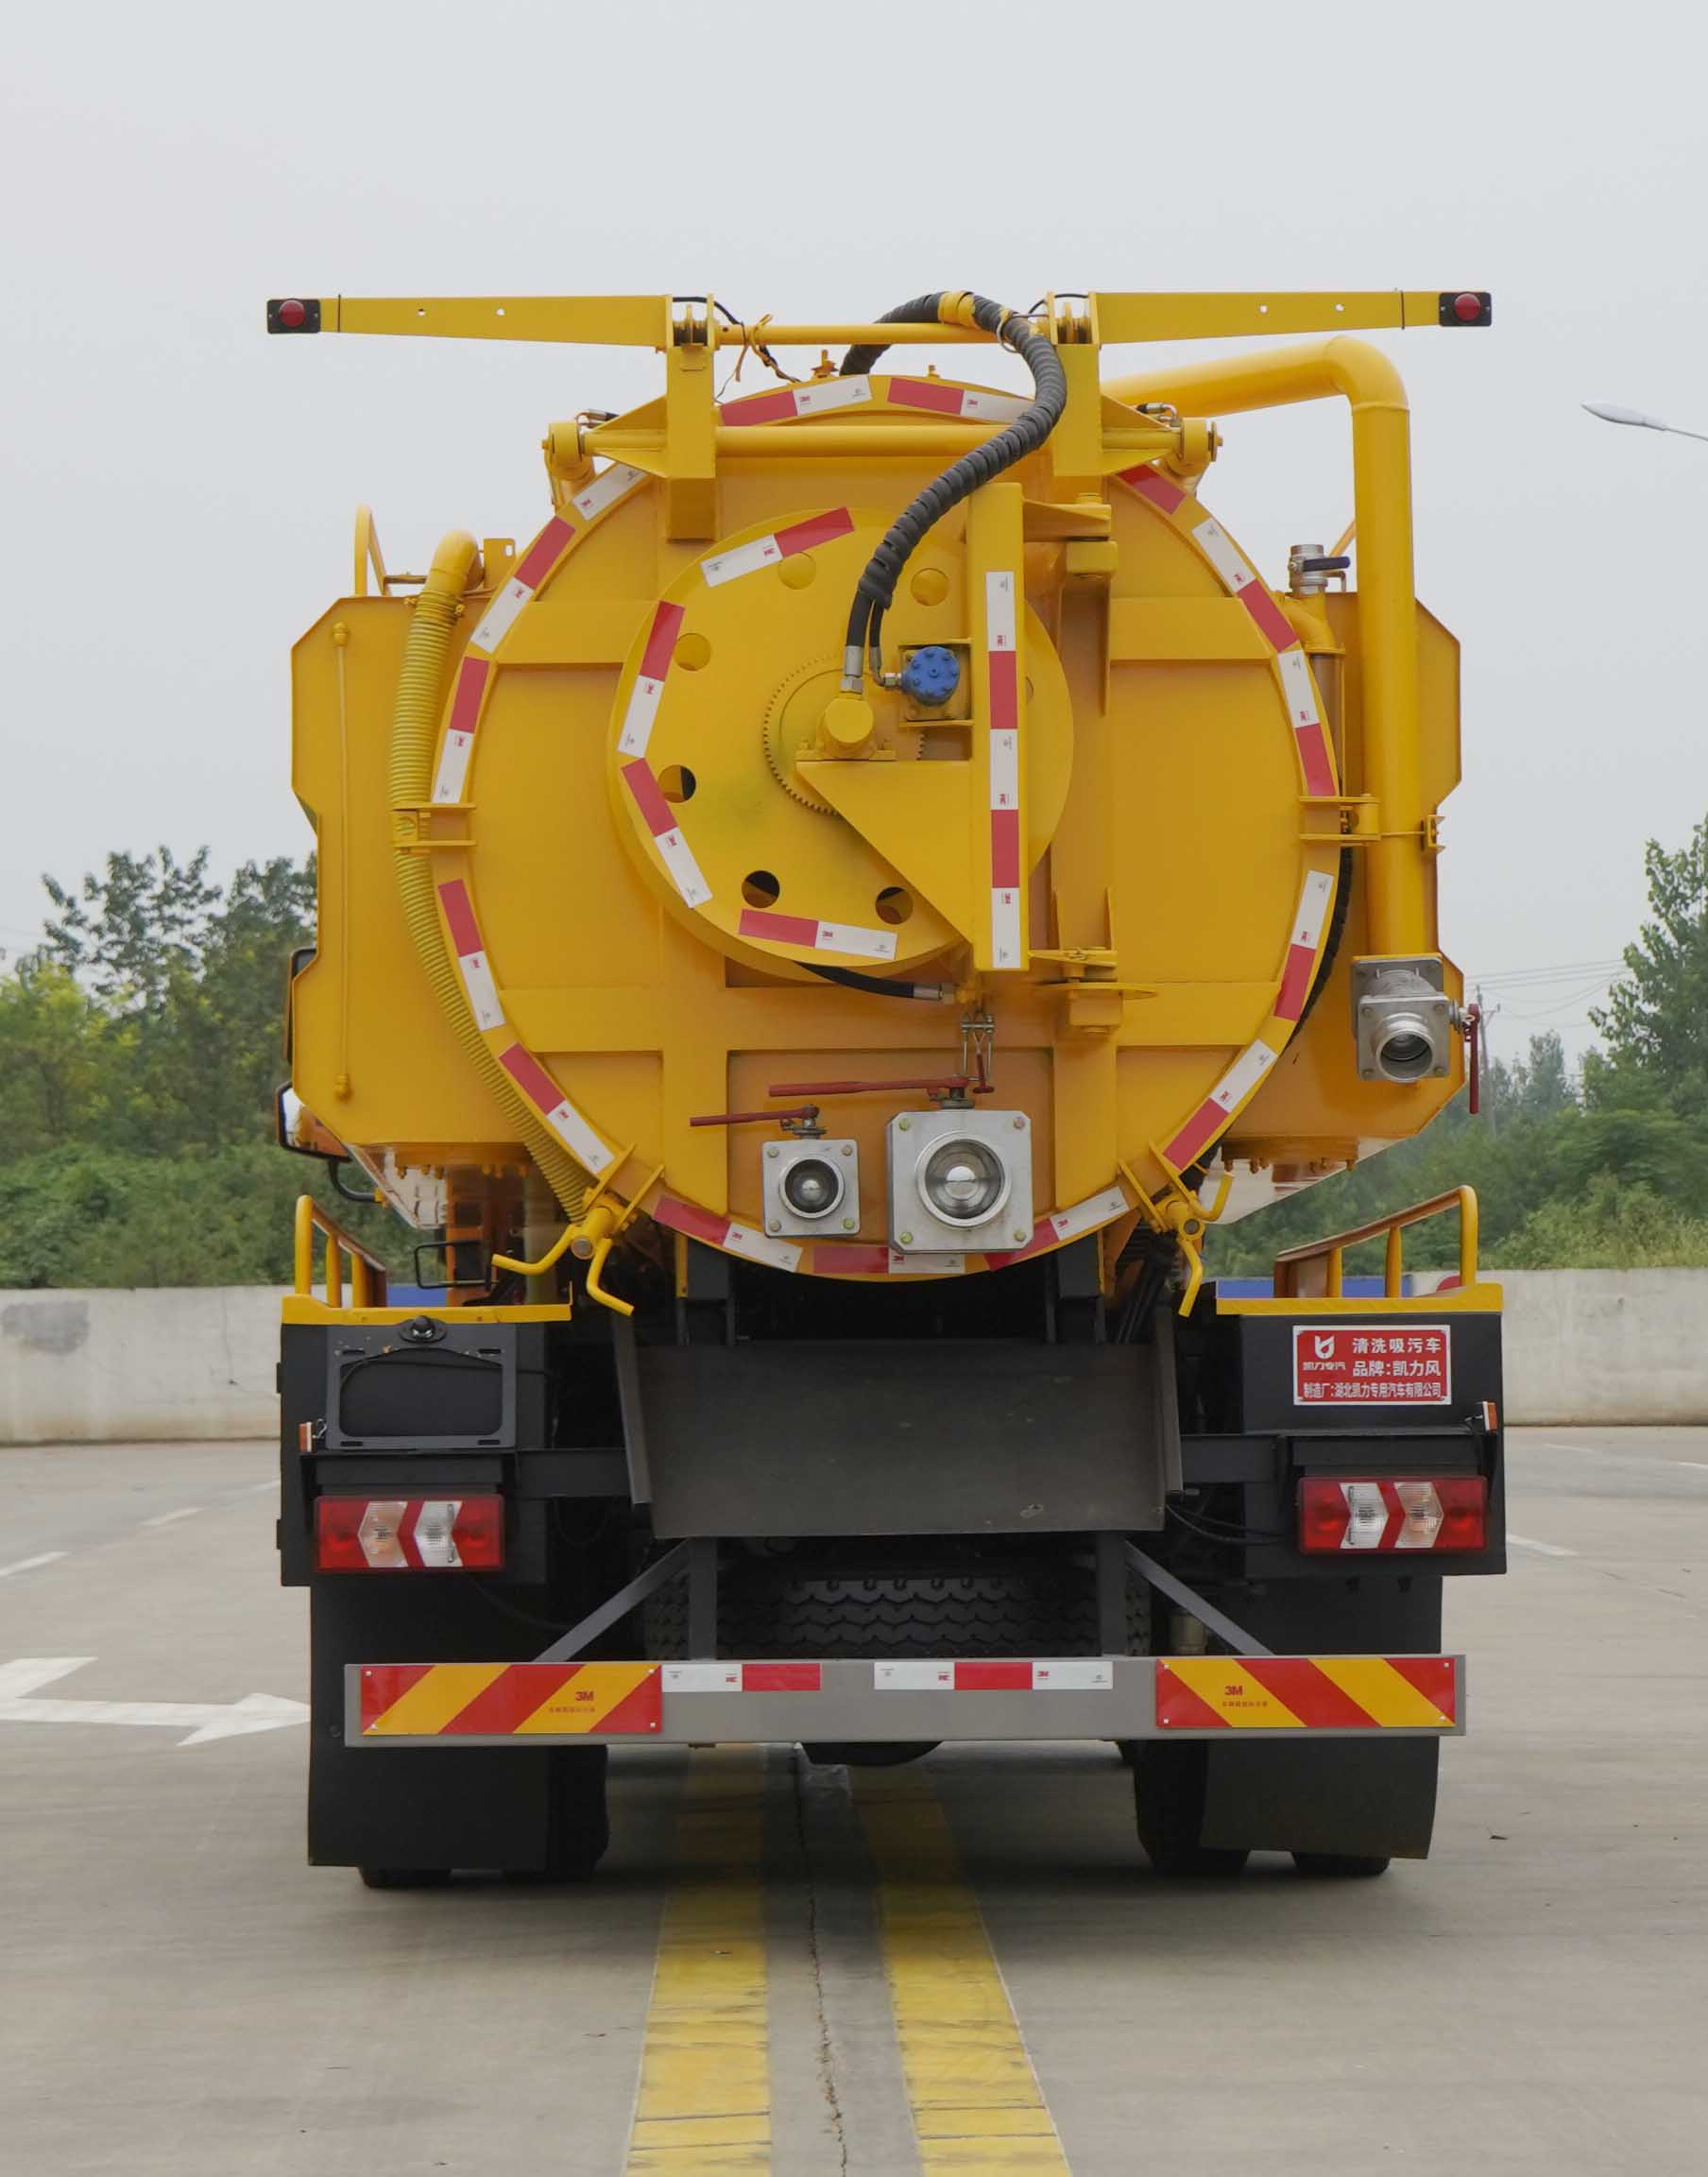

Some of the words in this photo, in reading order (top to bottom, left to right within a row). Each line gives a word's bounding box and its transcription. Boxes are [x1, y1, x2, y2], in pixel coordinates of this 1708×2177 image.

[1353, 1337, 1442, 1353] 清洗吸污车
[1224, 1685, 1242, 1696] 3M
[575, 1691, 594, 1702] 3M
